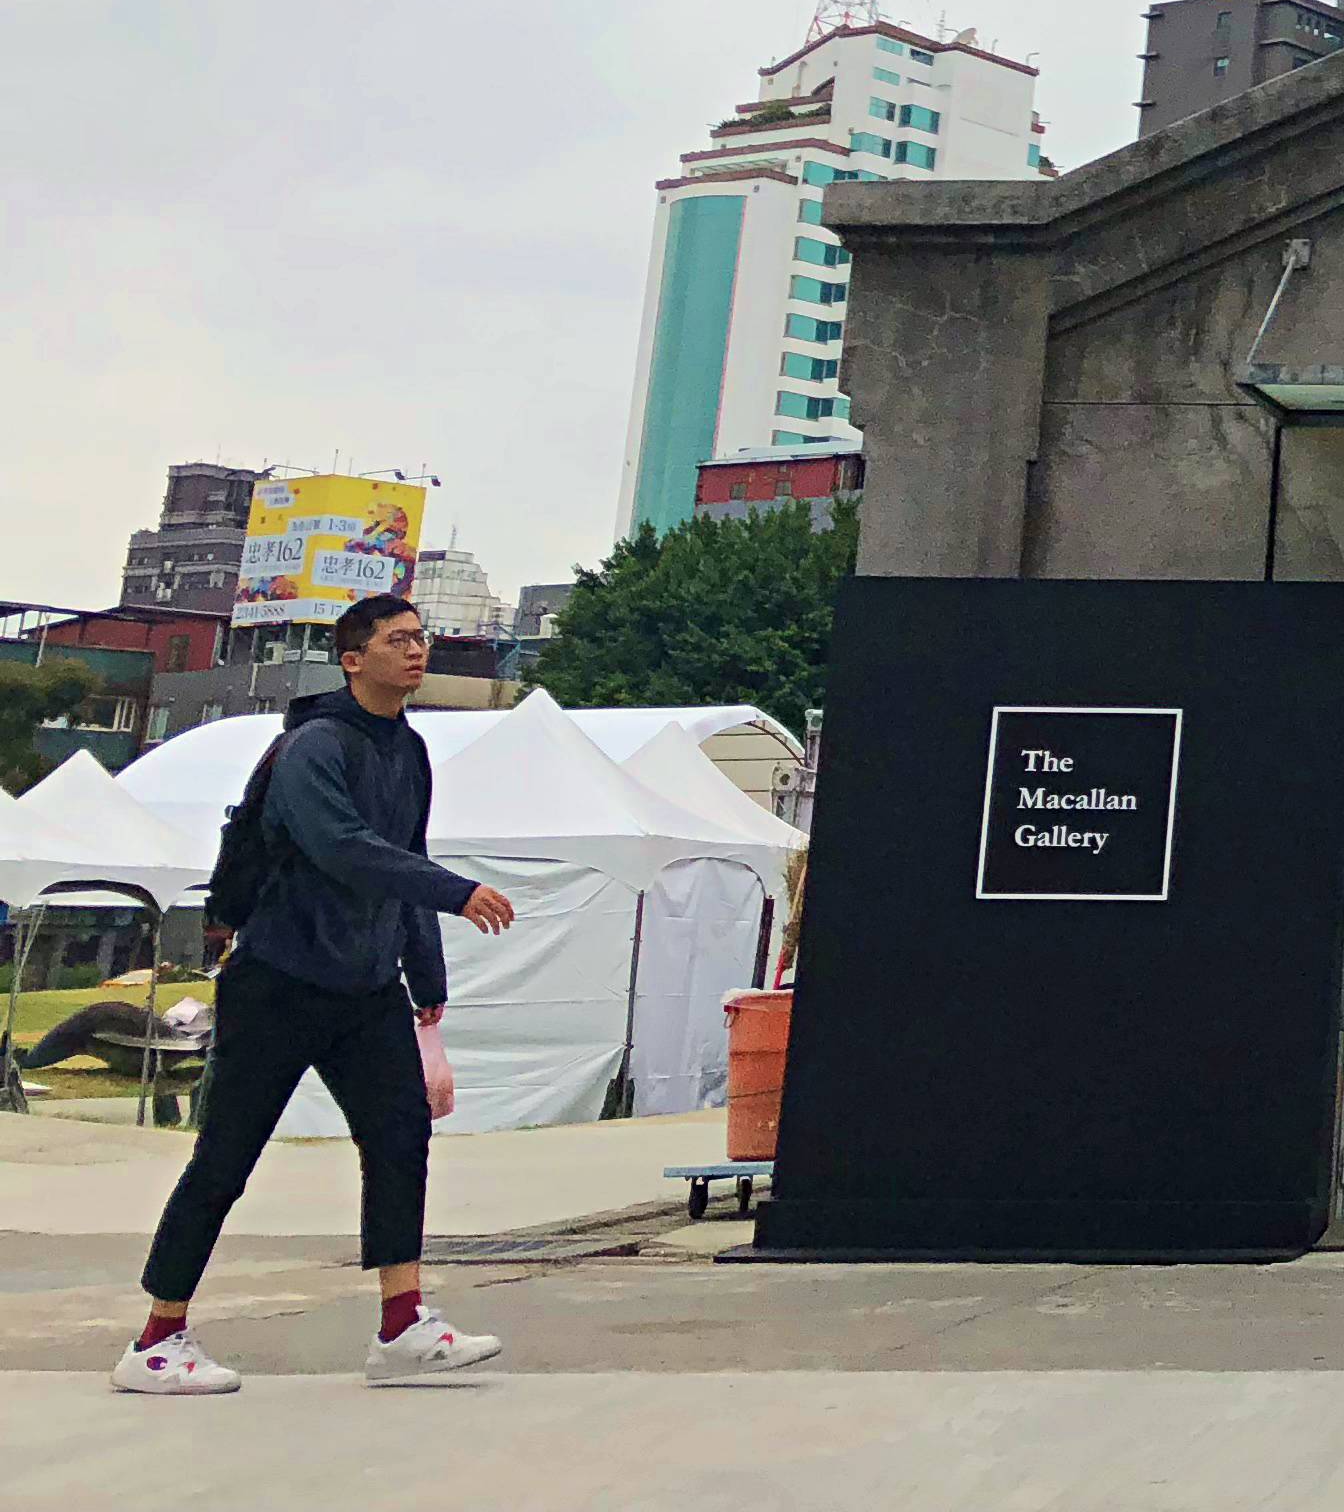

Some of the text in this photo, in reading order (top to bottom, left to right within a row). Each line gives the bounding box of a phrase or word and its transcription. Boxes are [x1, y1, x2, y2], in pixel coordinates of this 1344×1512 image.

[247, 537, 303, 564] 忠孝162
[321, 554, 386, 581] 忠孝162
[1021, 749, 1074, 772] The
[1016, 787, 1137, 810] Macallan
[1014, 824, 1109, 855] Gallery
